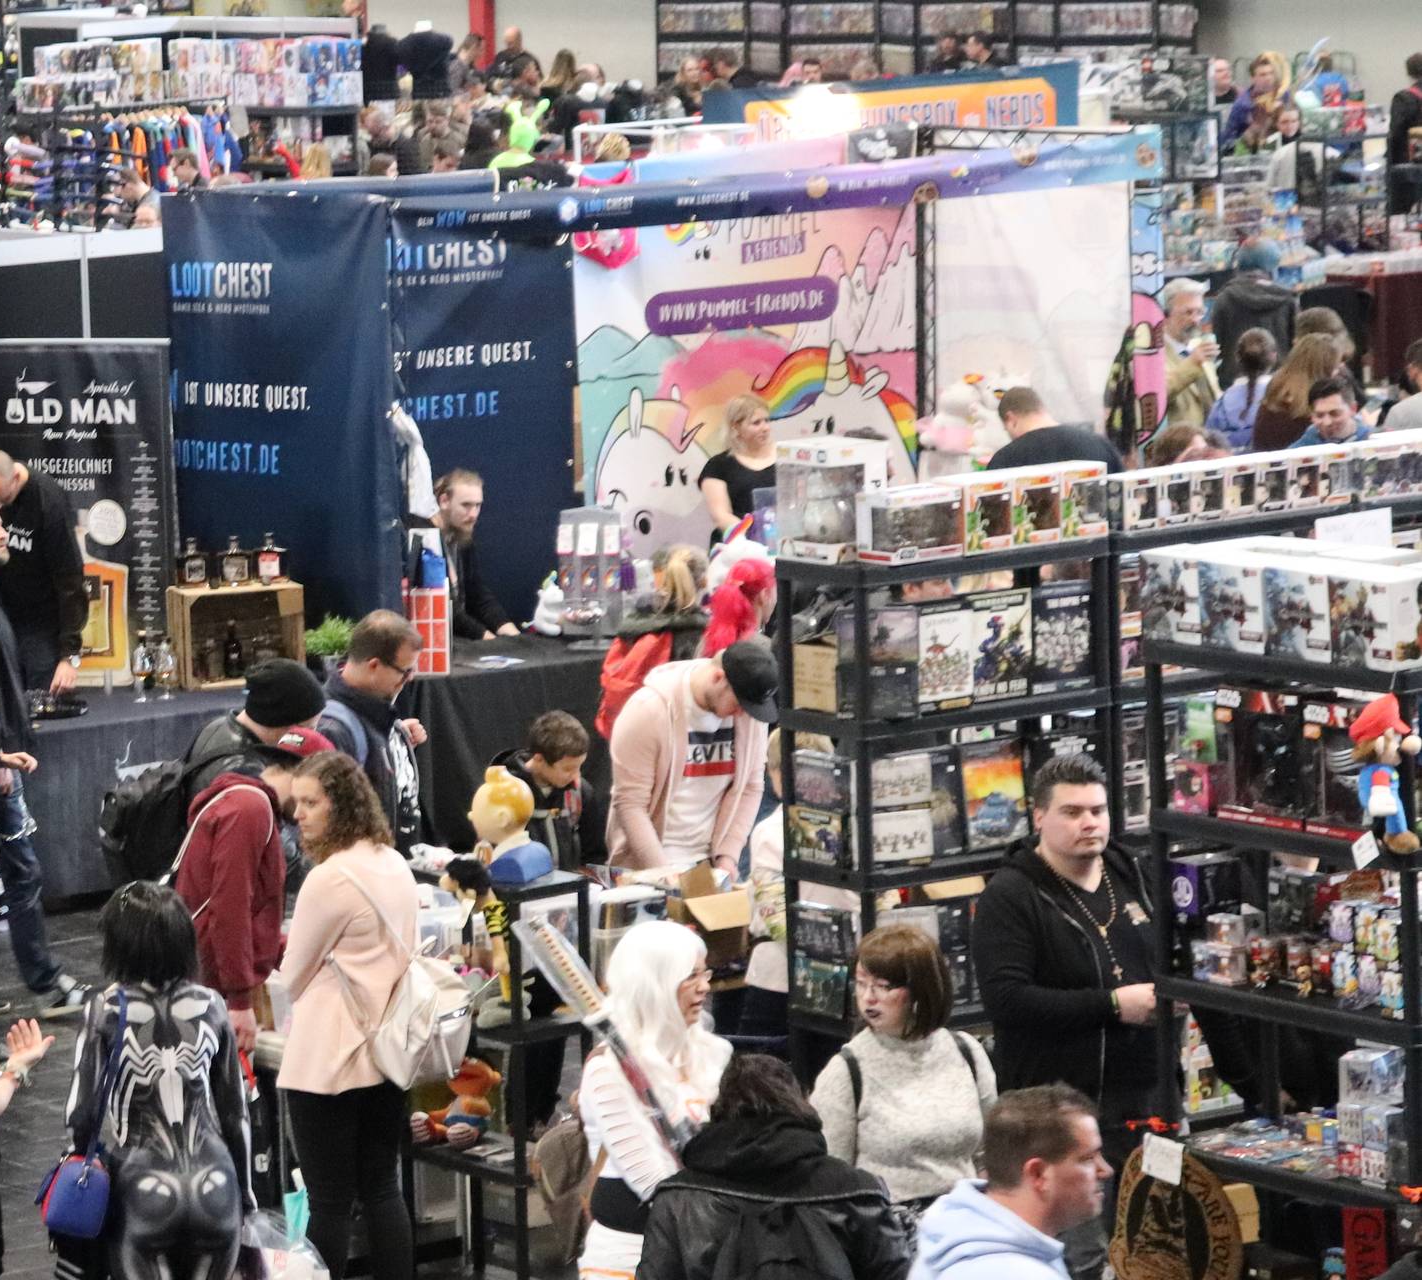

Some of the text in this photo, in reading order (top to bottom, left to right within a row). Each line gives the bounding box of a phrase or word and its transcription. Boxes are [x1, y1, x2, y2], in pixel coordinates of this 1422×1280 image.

[986, 92, 1046, 127] NERDS
[436, 209, 467, 228] WOW
[170, 261, 273, 299] LOOTCHEST
[416, 345, 475, 369] UNSERE
[481, 341, 537, 367] QUEST.
[184, 381, 199, 405] IST
[204, 382, 260, 408] UNSERE
[265, 385, 311, 412] QUEST.
[5, 398, 137, 424] OLD MAN
[8, 534, 33, 553] AN
